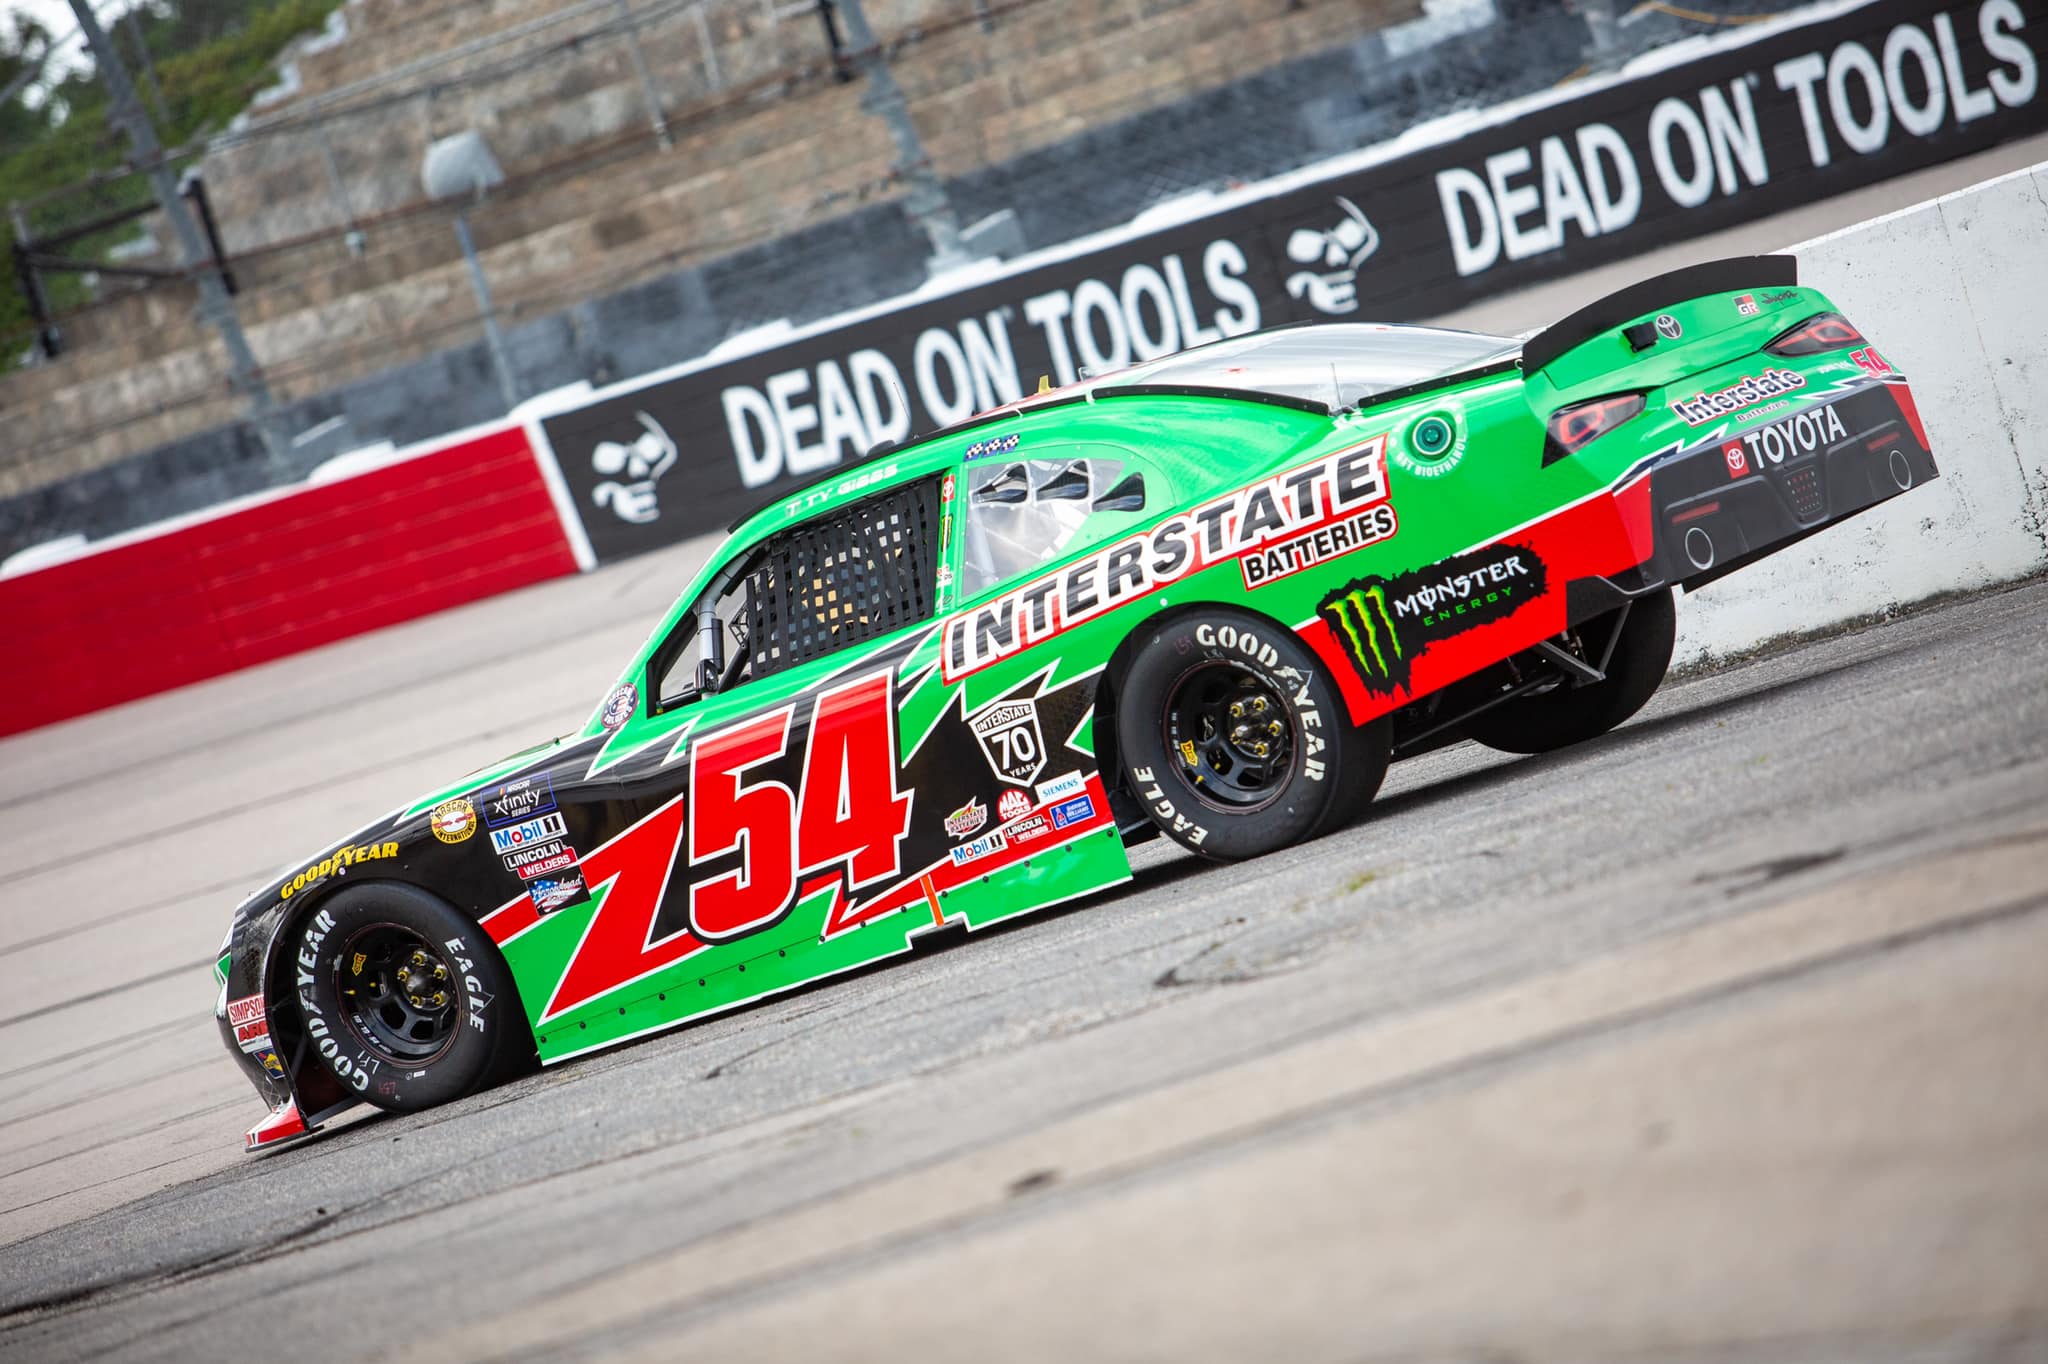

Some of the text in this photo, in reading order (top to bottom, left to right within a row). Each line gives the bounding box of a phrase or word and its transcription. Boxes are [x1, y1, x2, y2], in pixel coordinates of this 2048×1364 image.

[1436, 0, 2038, 276] DEAD ON TOOLS
[1739, 303, 1758, 315] GR
[721, 239, 1261, 489] DEAD ON TOOLS
[1848, 346, 1894, 378] 54
[1673, 370, 1804, 425] Interstate
[1736, 400, 1789, 422] Batteries
[1744, 404, 1847, 469] TOYOTA
[838, 464, 898, 495] GIBBS
[950, 444, 1379, 671] INTERSTATE
[1245, 507, 1394, 584] BATTERIES
[1394, 556, 1528, 617] MONSTER
[1424, 586, 1512, 626] ENERGY
[976, 703, 1031, 732] INTERSTATE
[1196, 624, 1326, 781] GOODYEAR
[991, 726, 1035, 770] 70
[1010, 762, 1037, 778] YEARS
[493, 789, 541, 815] xfinity
[689, 666, 914, 940] 54
[999, 790, 1029, 811] MAC
[1042, 779, 1078, 797] SIEMENS
[435, 801, 468, 819] NASCAR
[947, 808, 985, 826] INTERSTATE
[1133, 766, 1208, 845] EAGLE
[494, 820, 543, 848] Mobil
[950, 816, 985, 833] BATTERIES
[1007, 817, 1043, 837] LINCOLN
[507, 842, 562, 868] LINCOLN
[523, 854, 571, 876] WELDERS
[953, 840, 989, 861] Mobil
[281, 841, 399, 899] GOODYEAR
[297, 909, 369, 1091] GOODYEAR
[445, 937, 486, 1032] EAGLE
